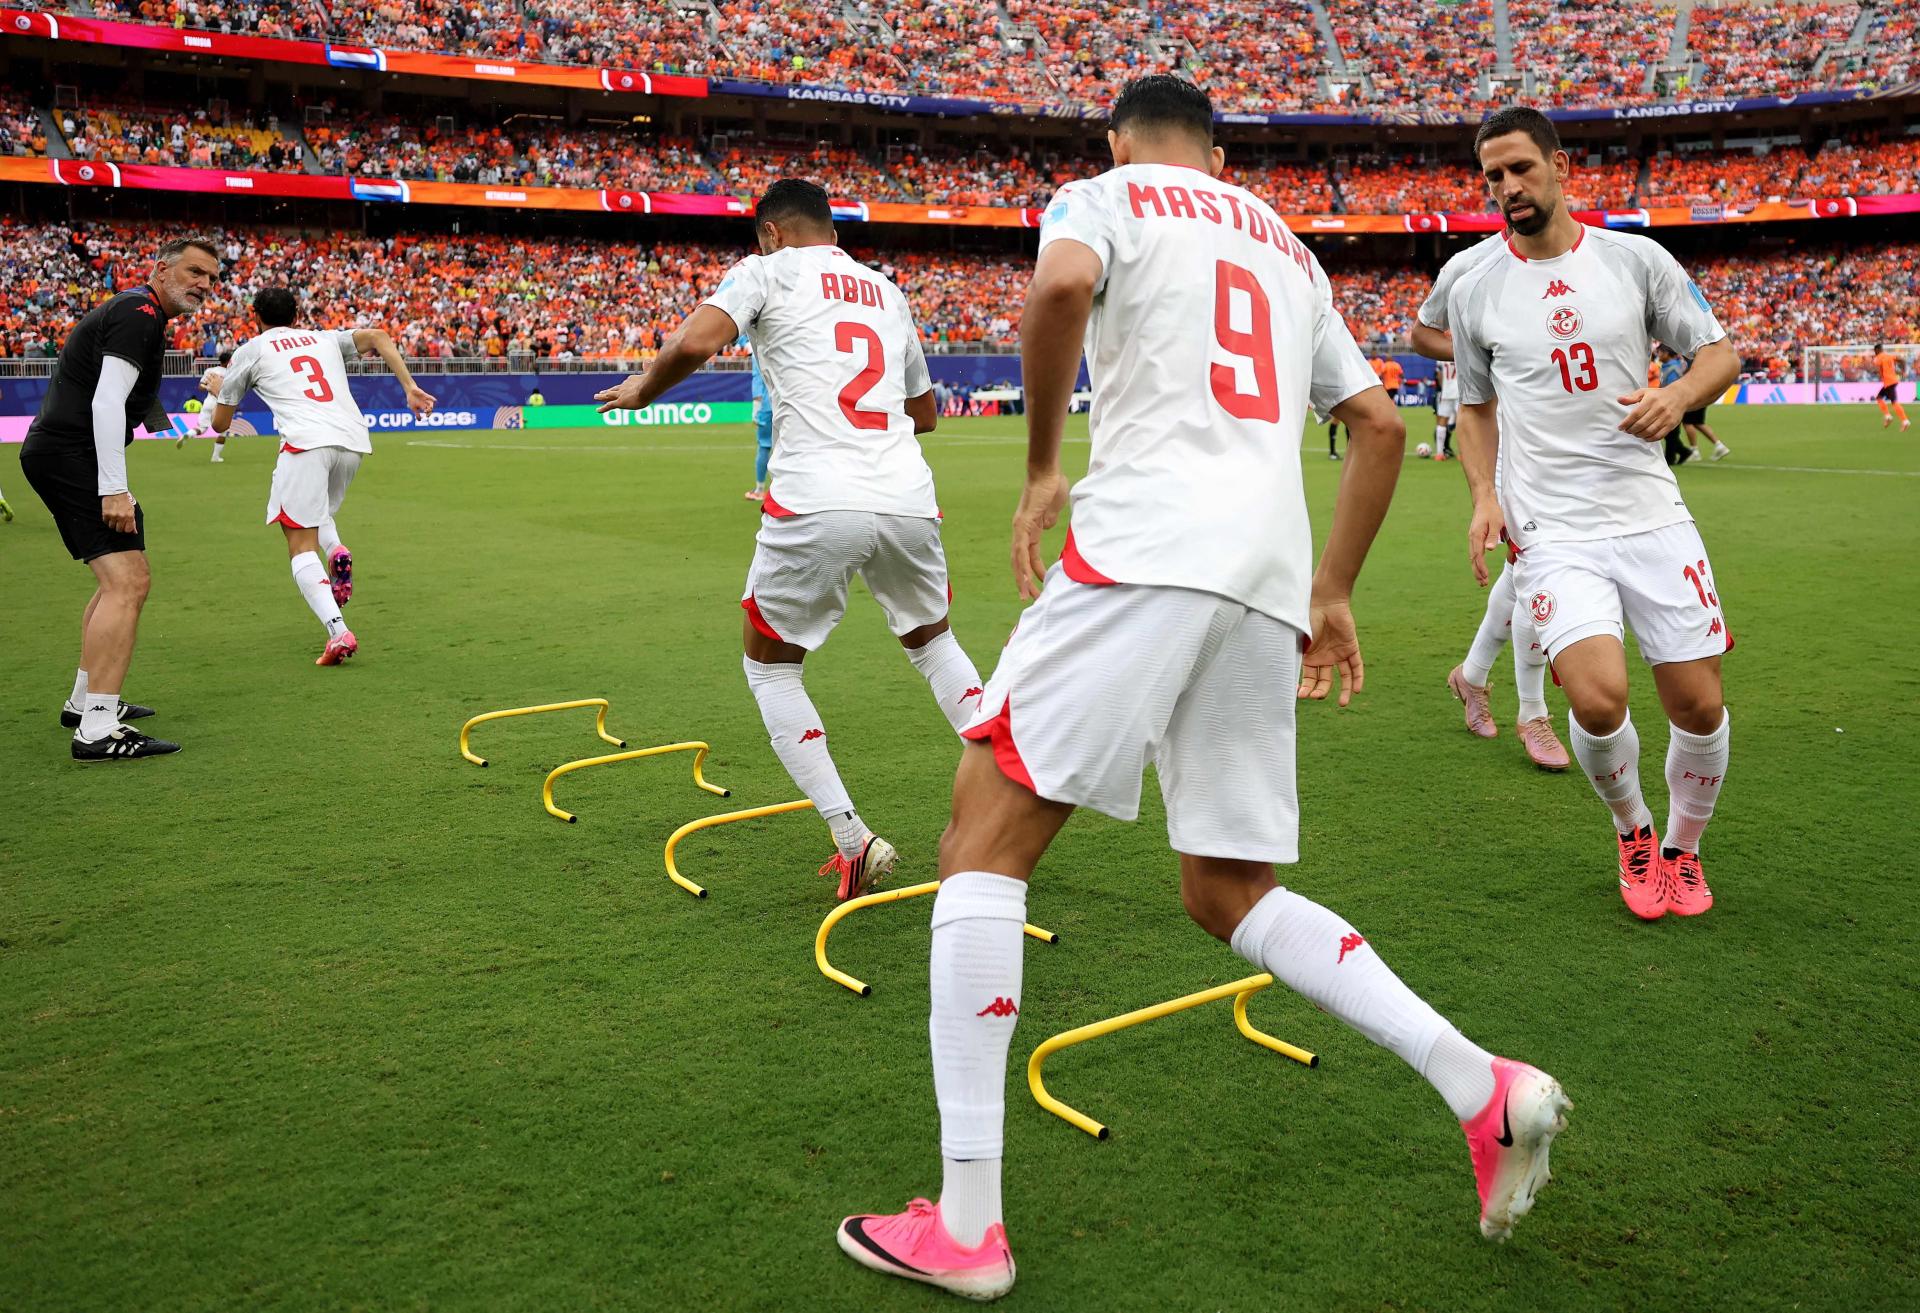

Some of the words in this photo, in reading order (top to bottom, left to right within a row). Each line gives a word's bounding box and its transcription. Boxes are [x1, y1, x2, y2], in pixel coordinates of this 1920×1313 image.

[788, 87, 867, 104] KANSAS
[868, 94, 910, 107] CITY
[1613, 104, 1691, 119] KANSAS
[1693, 101, 1738, 113] CITY
[820, 272, 885, 311] ABDI
[269, 335, 318, 353] TALBI
[1209, 259, 1280, 424] 9
[289, 355, 334, 403] 3
[834, 321, 888, 431] 2
[1550, 341, 1599, 395] 13
[379, 413, 412, 428] CUP
[414, 411, 472, 427] 2026
[602, 402, 712, 426] aramco
[1594, 761, 1628, 781] FTF
[1683, 771, 1722, 787] FTF
